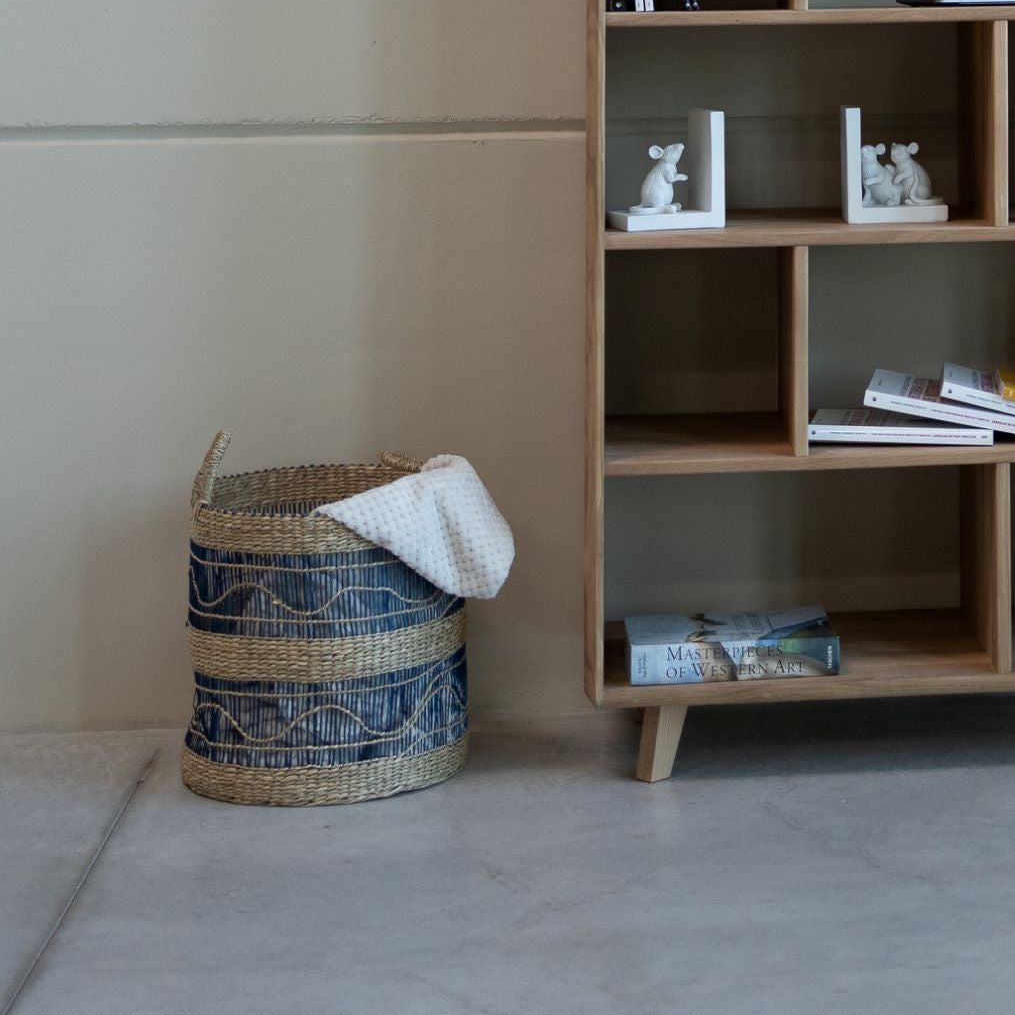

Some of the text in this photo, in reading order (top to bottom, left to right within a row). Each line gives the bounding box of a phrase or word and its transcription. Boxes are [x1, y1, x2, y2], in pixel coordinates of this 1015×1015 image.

[667, 645, 783, 661] MASTERPIECES
[666, 660, 806, 679] OF WESTERN ART
